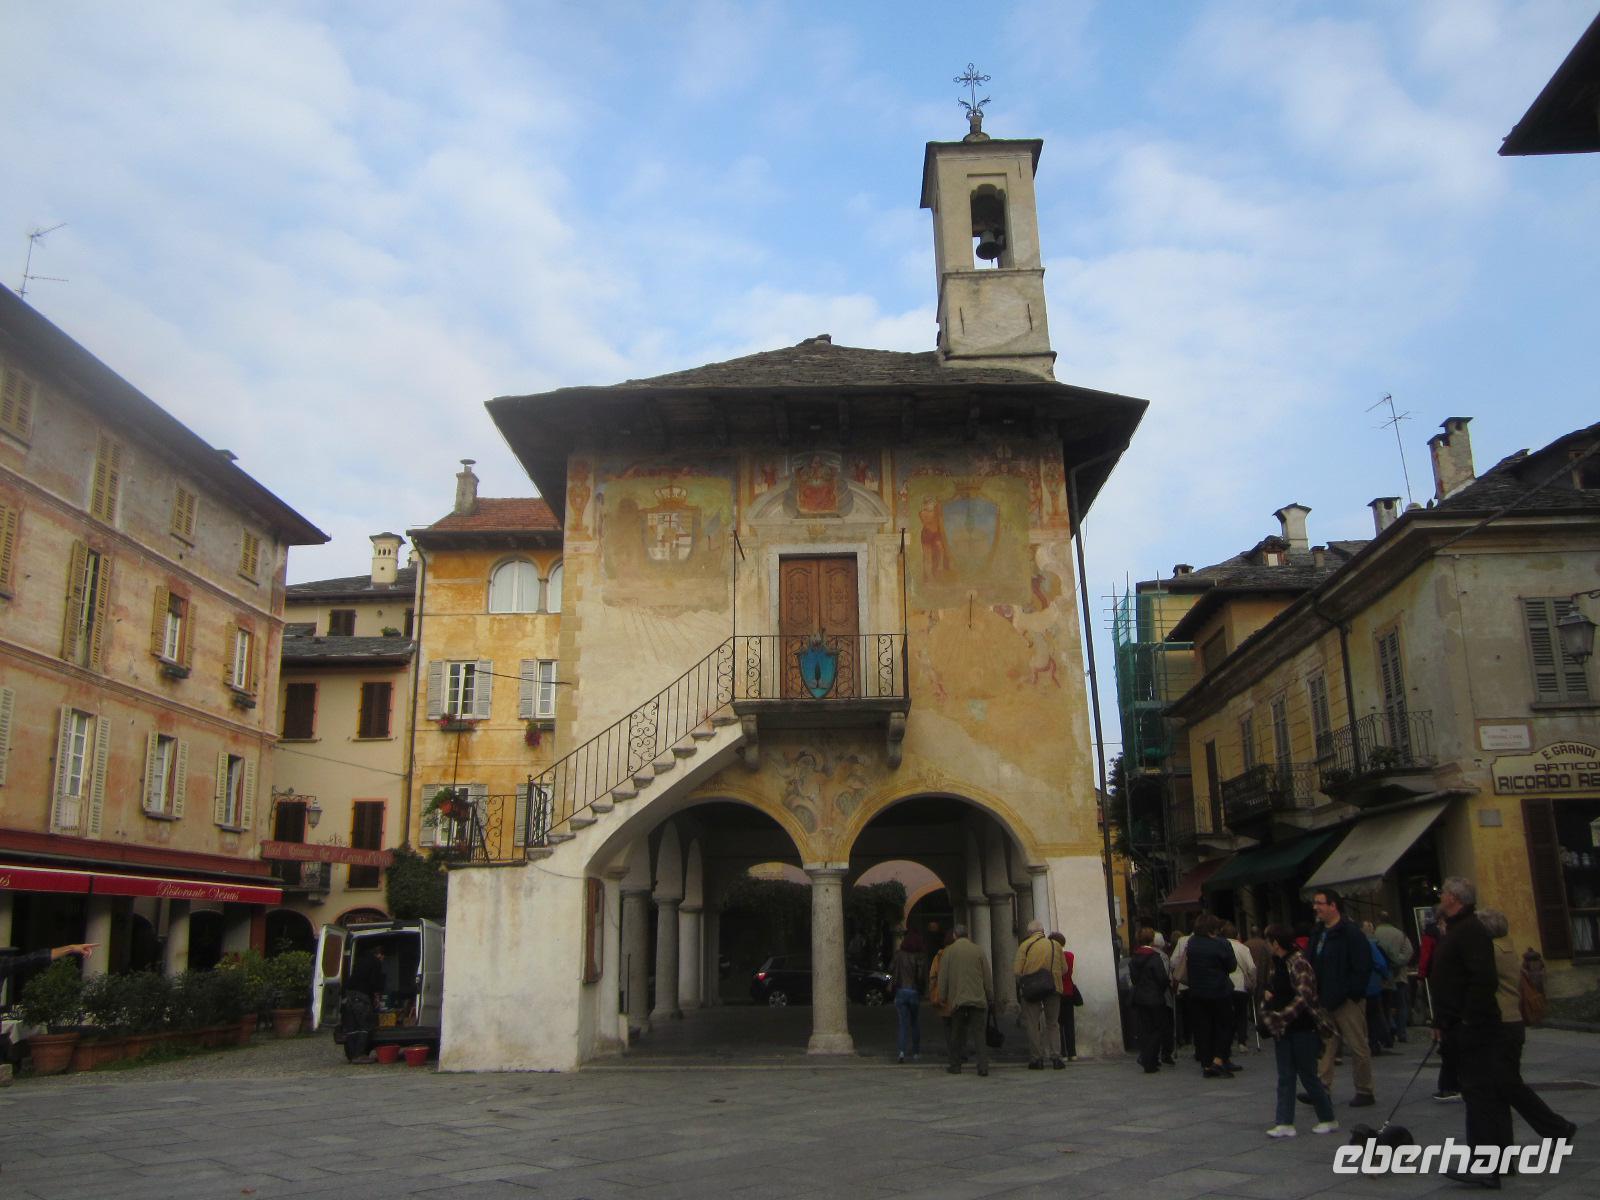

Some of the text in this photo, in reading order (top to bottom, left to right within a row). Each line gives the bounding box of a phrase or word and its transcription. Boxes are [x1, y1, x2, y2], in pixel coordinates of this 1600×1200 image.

[1541, 744, 1597, 761] E GRANDI
[1498, 773, 1571, 790] RICORDO
[156, 881, 206, 897] Ristorante
